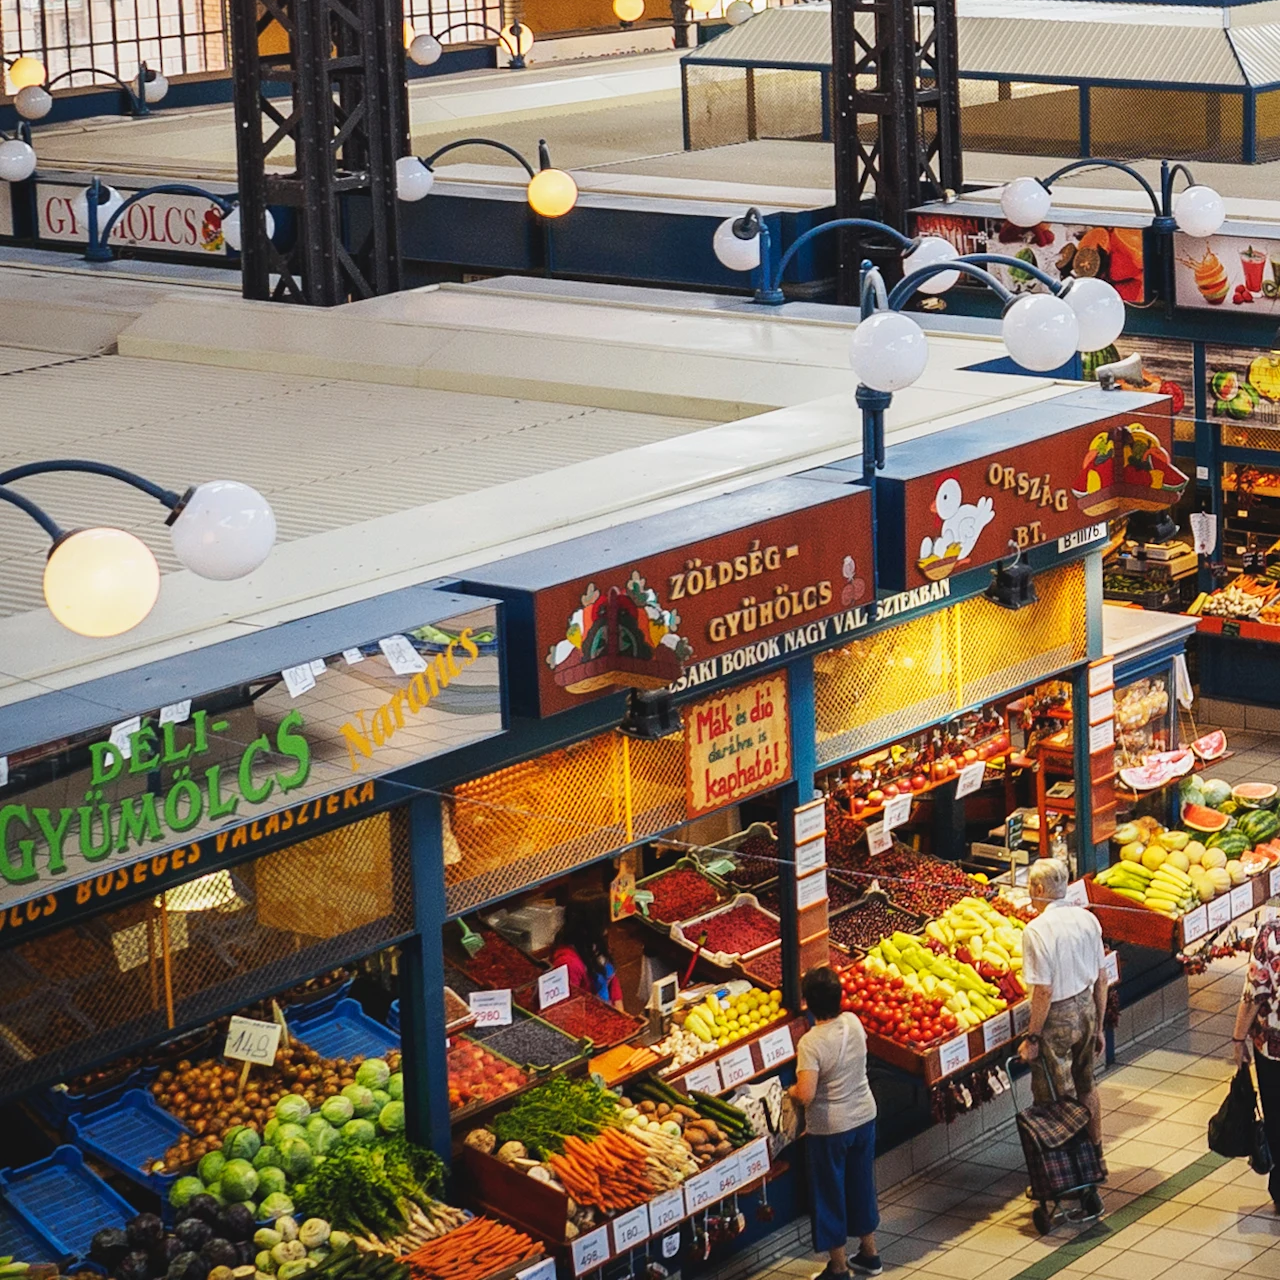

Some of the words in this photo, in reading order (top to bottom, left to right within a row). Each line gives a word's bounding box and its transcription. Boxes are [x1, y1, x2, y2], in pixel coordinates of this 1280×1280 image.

[988, 462, 1069, 512] ORSZÁG
[721, 636, 781, 676] BOROK
[784, 619, 830, 653] NAGY
[338, 626, 479, 772] Narancs
[696, 702, 732, 744] Mák
[736, 704, 747, 726] és
[750, 686, 774, 723] dió
[89, 710, 229, 786] DÉLI-
[705, 741, 780, 803] kapható!
[0, 709, 311, 884] GYÜMÖLCS
[544, 987, 560, 1001] 700
[728, 1069, 744, 1083] 100
[657, 1209, 674, 1227] 120
[692, 1190, 709, 1207] 120
